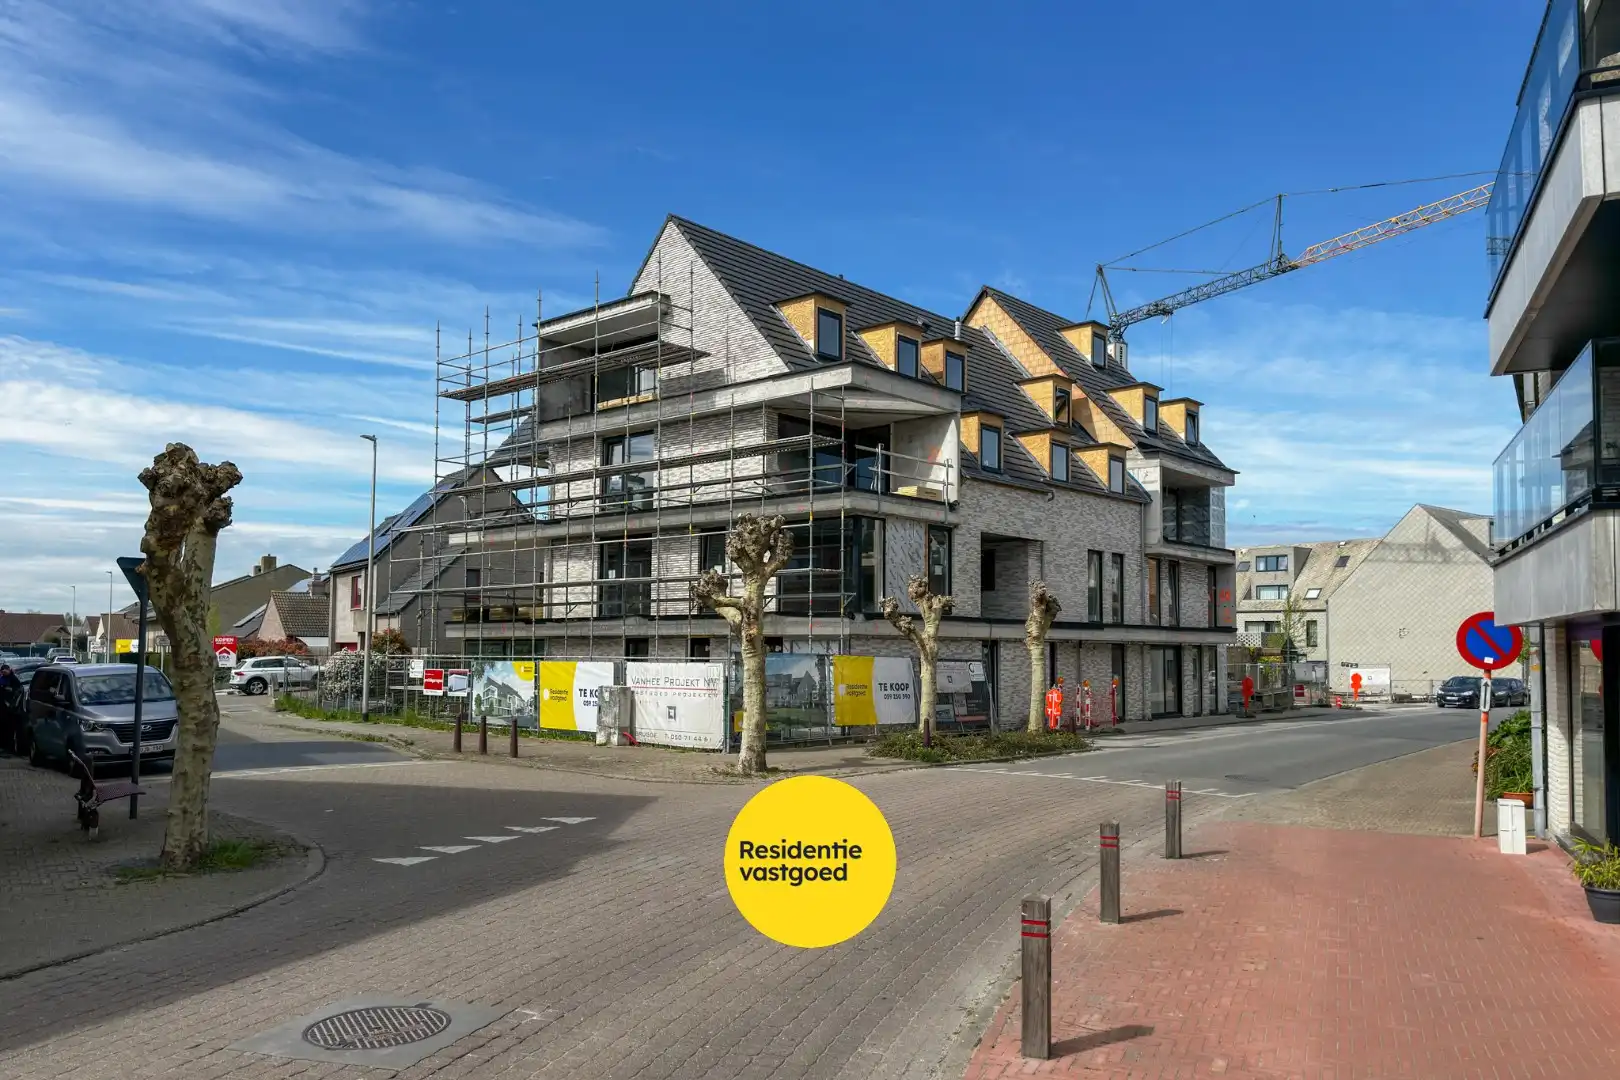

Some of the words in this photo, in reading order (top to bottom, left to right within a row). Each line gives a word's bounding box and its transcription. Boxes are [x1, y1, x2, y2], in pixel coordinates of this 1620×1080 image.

[631, 675, 660, 686] VANHEE
[664, 676, 700, 687] PROJEKT
[878, 682, 888, 691] TE
[889, 682, 910, 691] KOOP
[578, 688, 587, 698] TE
